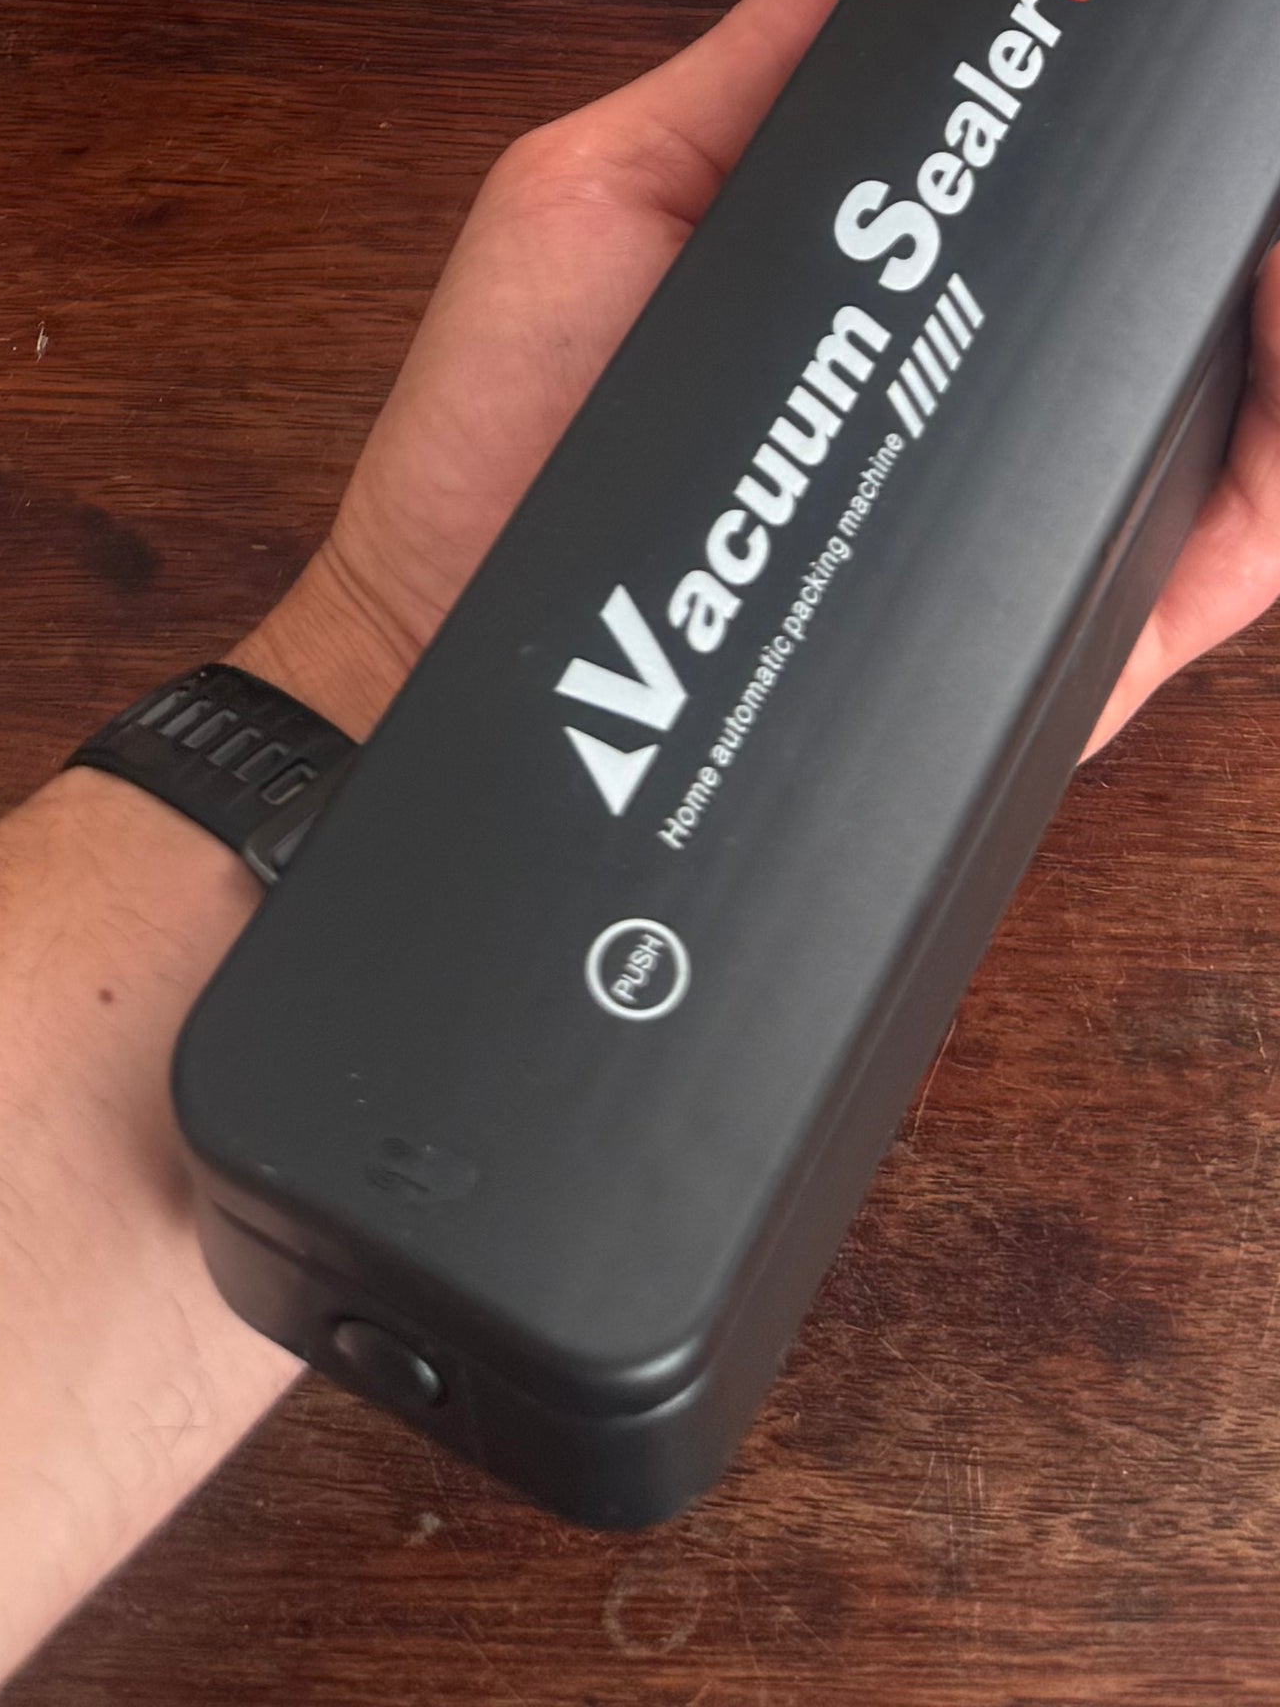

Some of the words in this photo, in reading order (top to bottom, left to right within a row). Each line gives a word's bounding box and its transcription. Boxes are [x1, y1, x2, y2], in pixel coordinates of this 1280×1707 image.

[553, 301, 894, 735] Vacuum
[657, 756, 724, 853] Home
[710, 629, 801, 772] automatic
[779, 529, 854, 642] packing
[836, 428, 908, 543] machine
[609, 932, 665, 1004] PUSH
